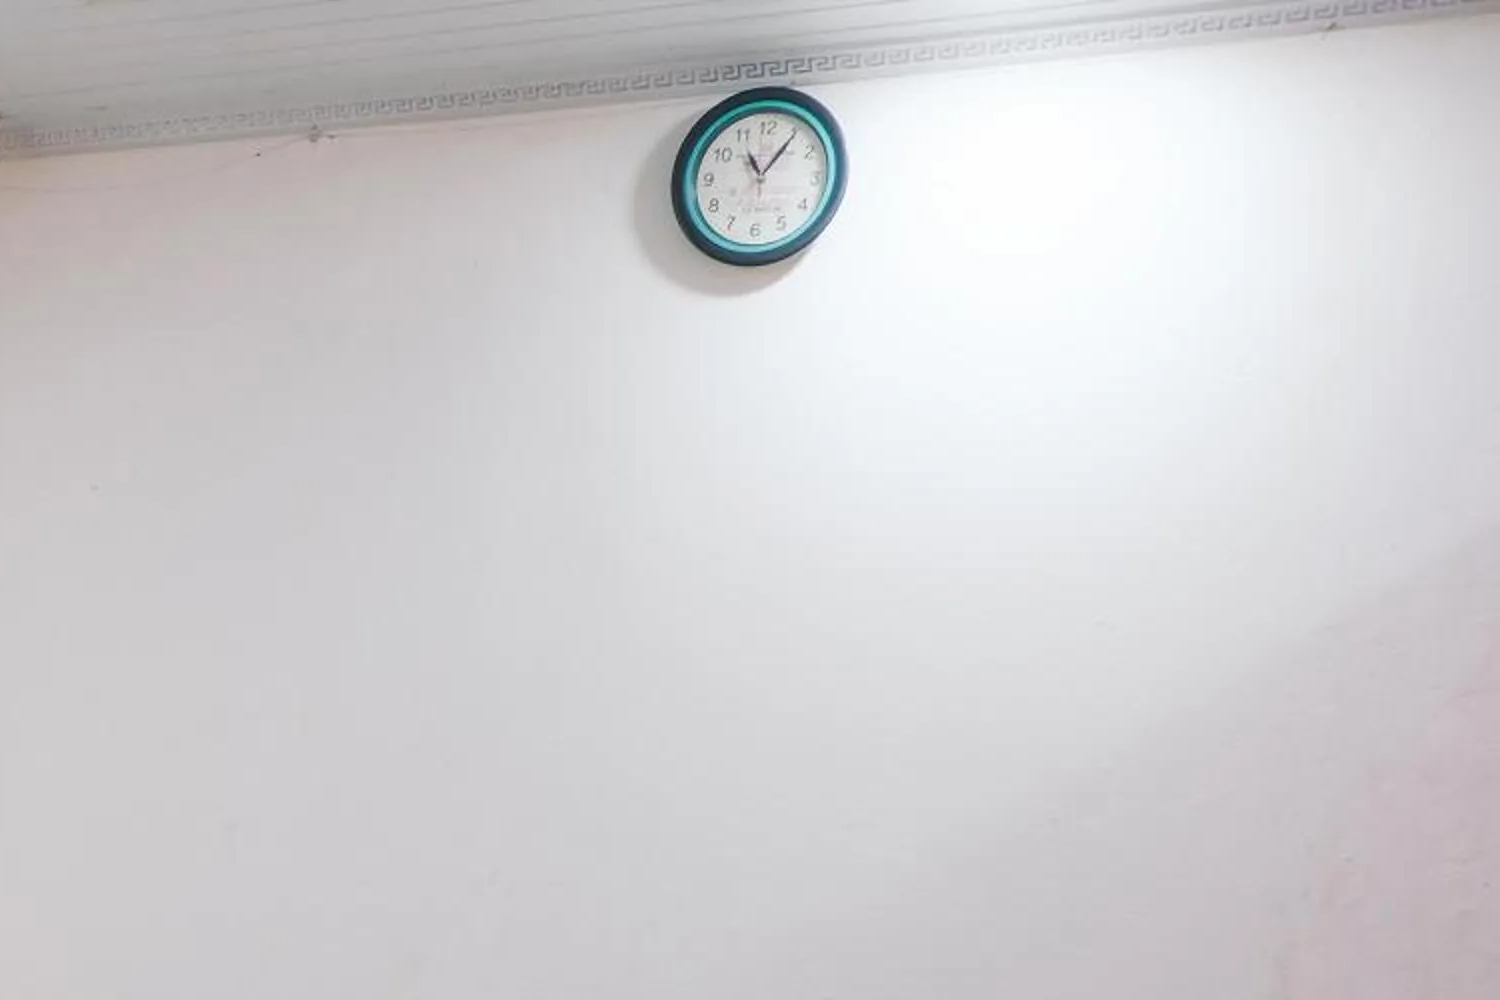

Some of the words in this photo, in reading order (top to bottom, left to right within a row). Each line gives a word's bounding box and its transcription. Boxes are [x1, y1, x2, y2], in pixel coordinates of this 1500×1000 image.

[737, 128, 750, 143] 11
[760, 121, 778, 136] 12
[714, 147, 733, 163] 10
[804, 144, 815, 160] 2
[704, 173, 715, 187] 9
[708, 198, 719, 213] 8
[797, 197, 807, 210] 4
[726, 214, 736, 231] 7
[775, 215, 786, 231] 5
[749, 223, 761, 238] 6
